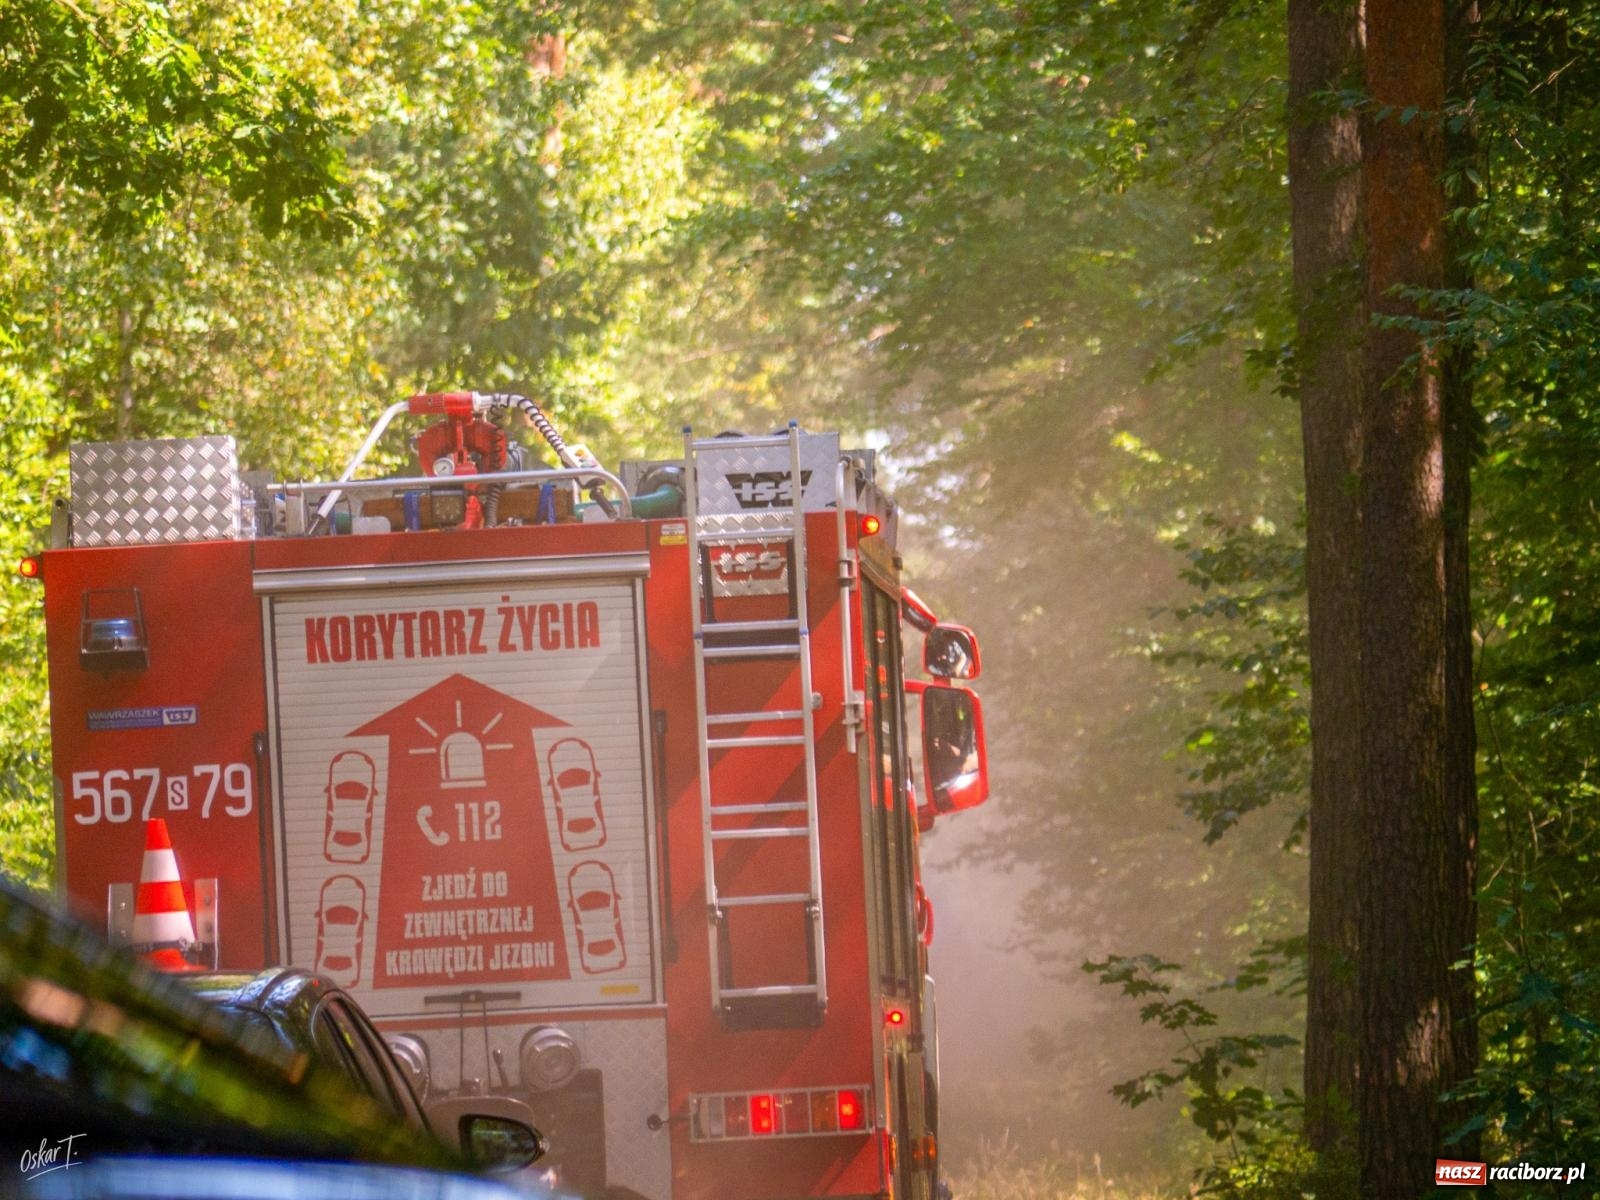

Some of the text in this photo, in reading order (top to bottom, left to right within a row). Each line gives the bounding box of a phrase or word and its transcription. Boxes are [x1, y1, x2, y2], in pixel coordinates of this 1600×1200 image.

[305, 595, 600, 664] KORYTARZ ŻYCIA
[88, 708, 160, 720] WAWRZASZEK
[454, 801, 502, 841] 112
[422, 867, 508, 901] ZJEDŹ DO
[404, 906, 535, 941] ZEWNĘTRZNEJ
[386, 942, 555, 978] KRAWĘDZI JEZDNI
